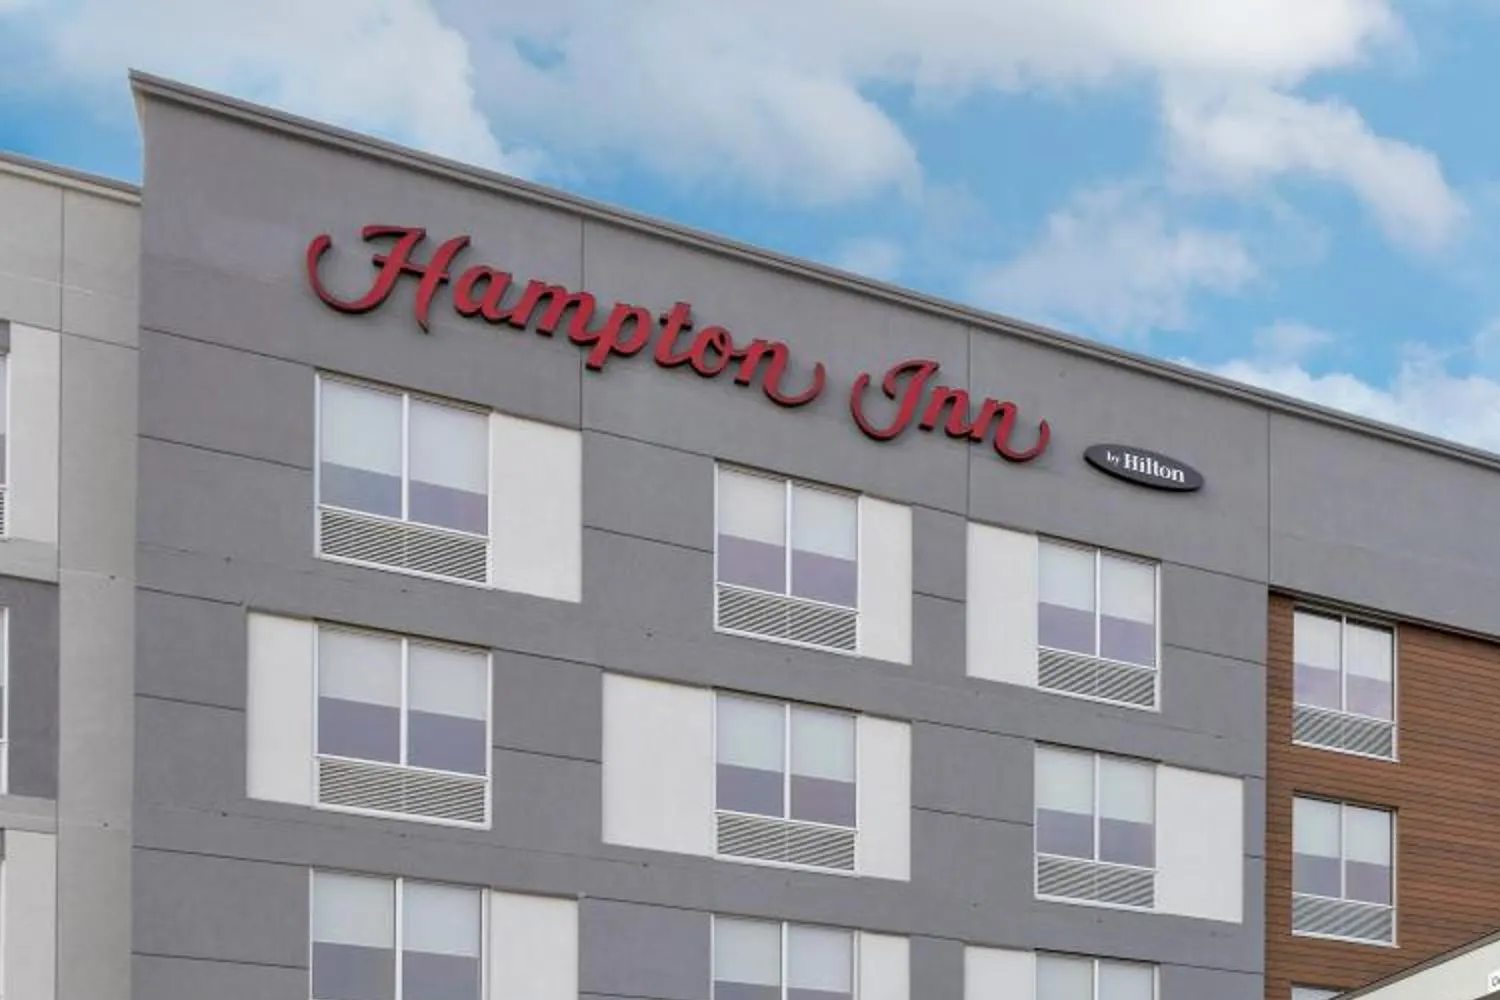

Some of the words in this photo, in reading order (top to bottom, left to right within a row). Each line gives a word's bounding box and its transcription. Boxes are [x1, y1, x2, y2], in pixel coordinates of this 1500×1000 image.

[305, 224, 825, 407] Hampton
[851, 359, 1050, 463] Inn
[1106, 450, 1120, 466] by
[1123, 452, 1185, 483] Hilton
